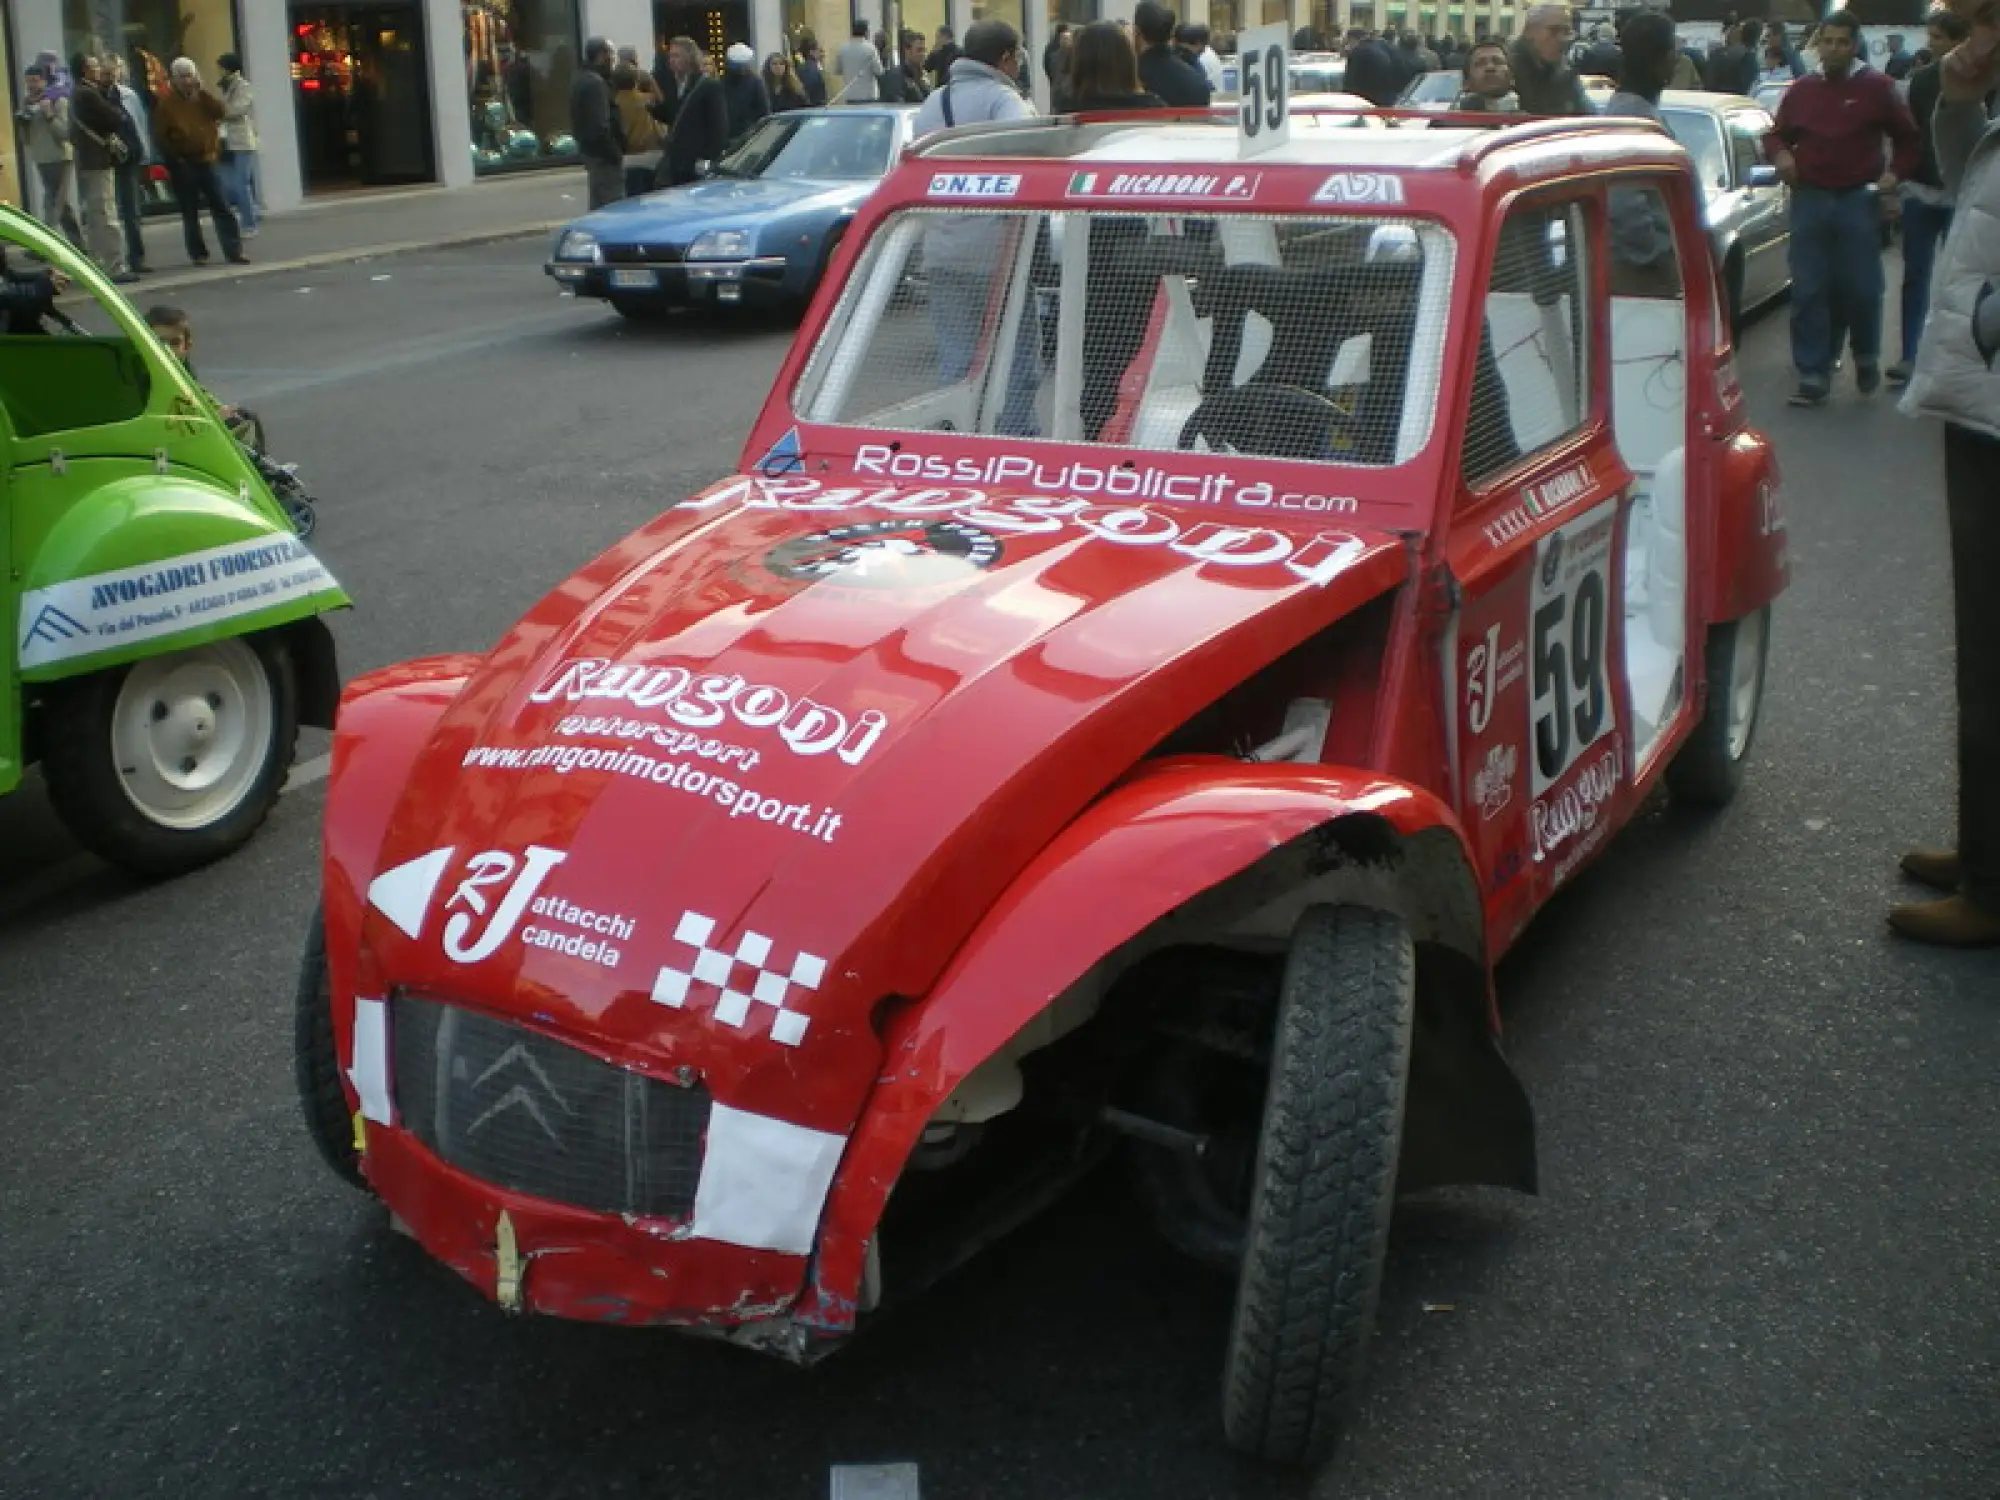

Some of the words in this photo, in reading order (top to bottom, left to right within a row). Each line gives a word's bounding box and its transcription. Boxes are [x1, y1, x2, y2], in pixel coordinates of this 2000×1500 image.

[1242, 45, 1284, 138] 59
[92, 561, 206, 611] AVOGADRI
[1534, 568, 1604, 780] 59
[531, 896, 637, 941] attacchi
[520, 924, 622, 969] candela
